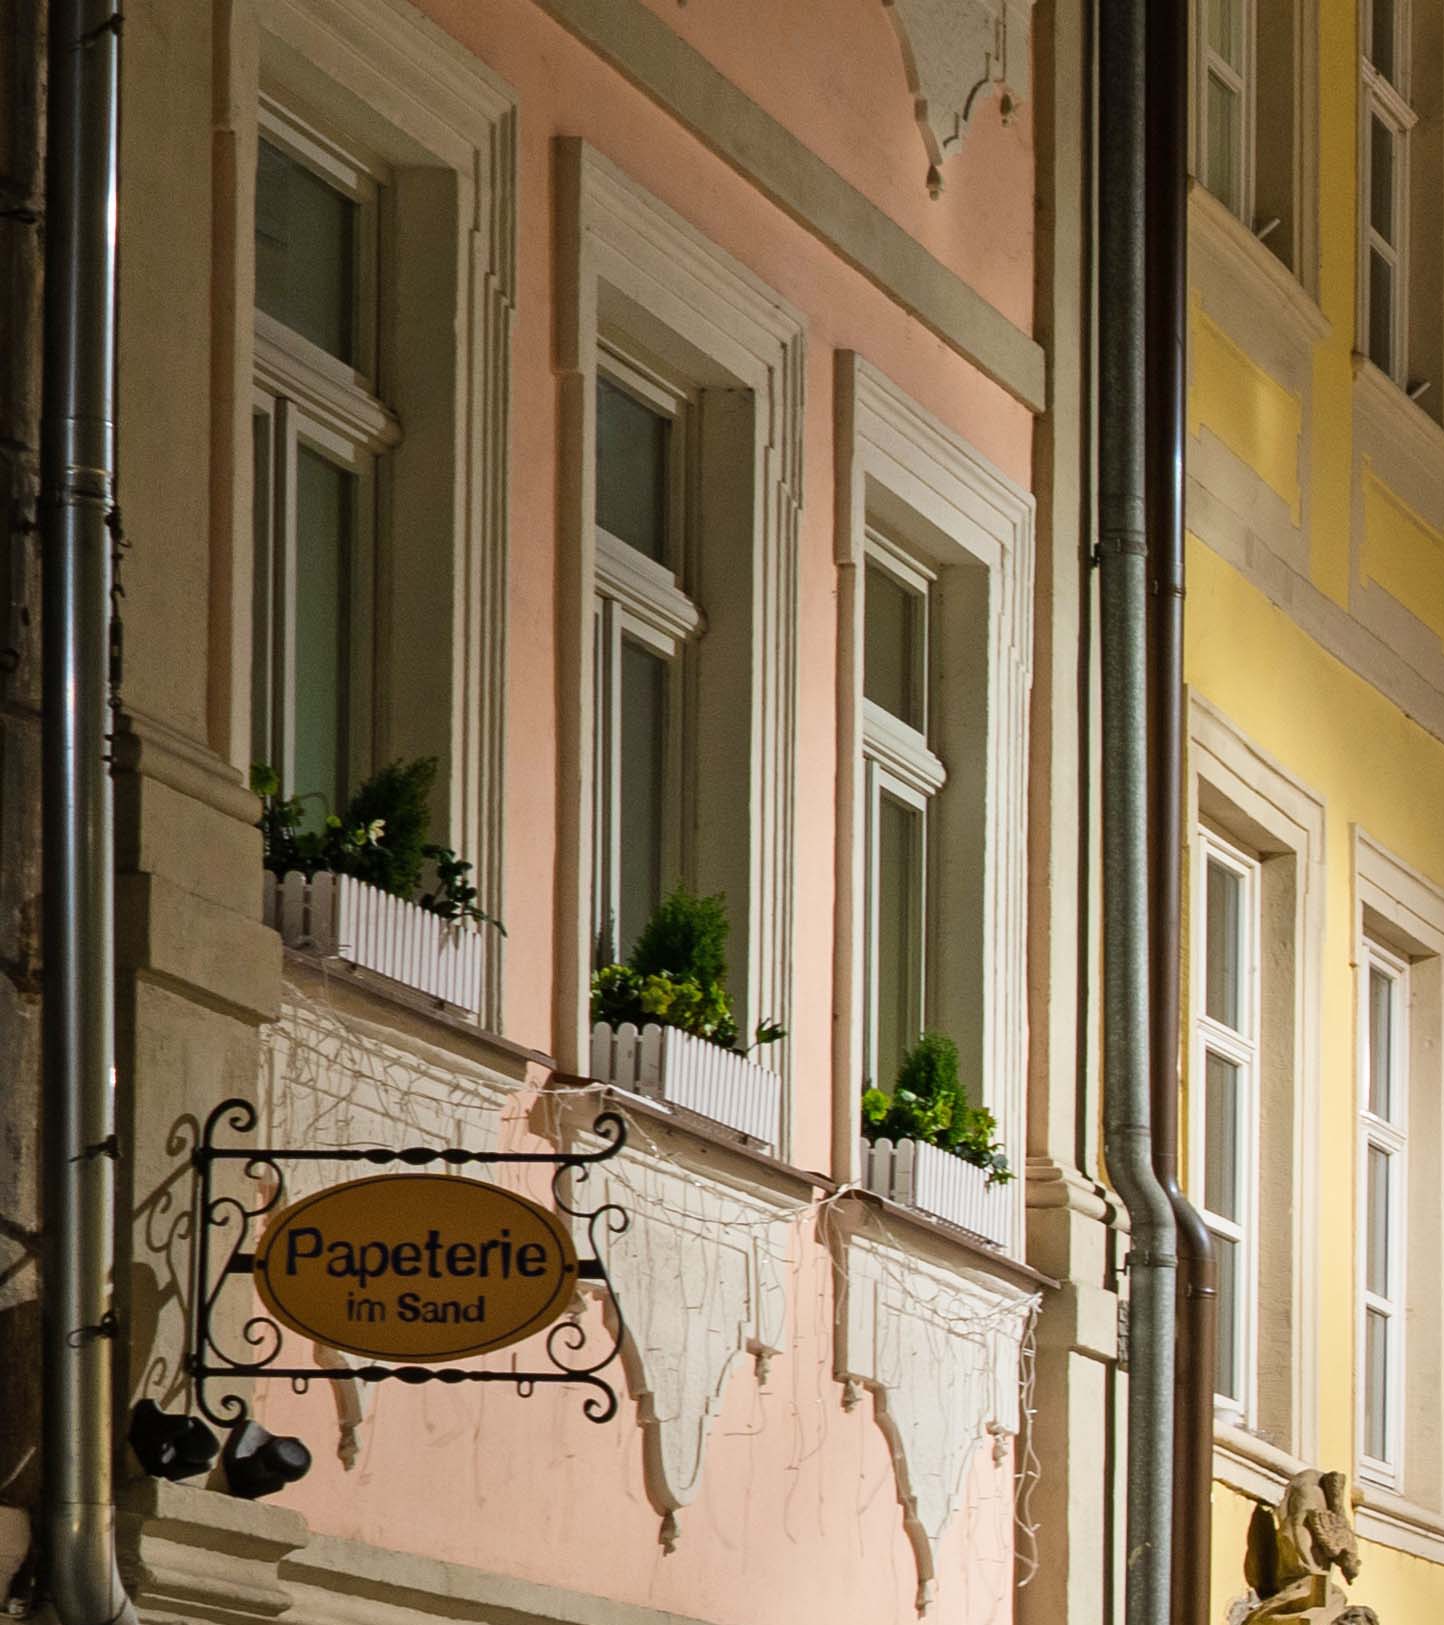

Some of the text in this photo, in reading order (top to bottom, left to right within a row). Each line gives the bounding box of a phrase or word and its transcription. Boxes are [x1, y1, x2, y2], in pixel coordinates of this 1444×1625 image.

[285, 1226, 548, 1288] Papeterie
[347, 1293, 486, 1324] im Sand
